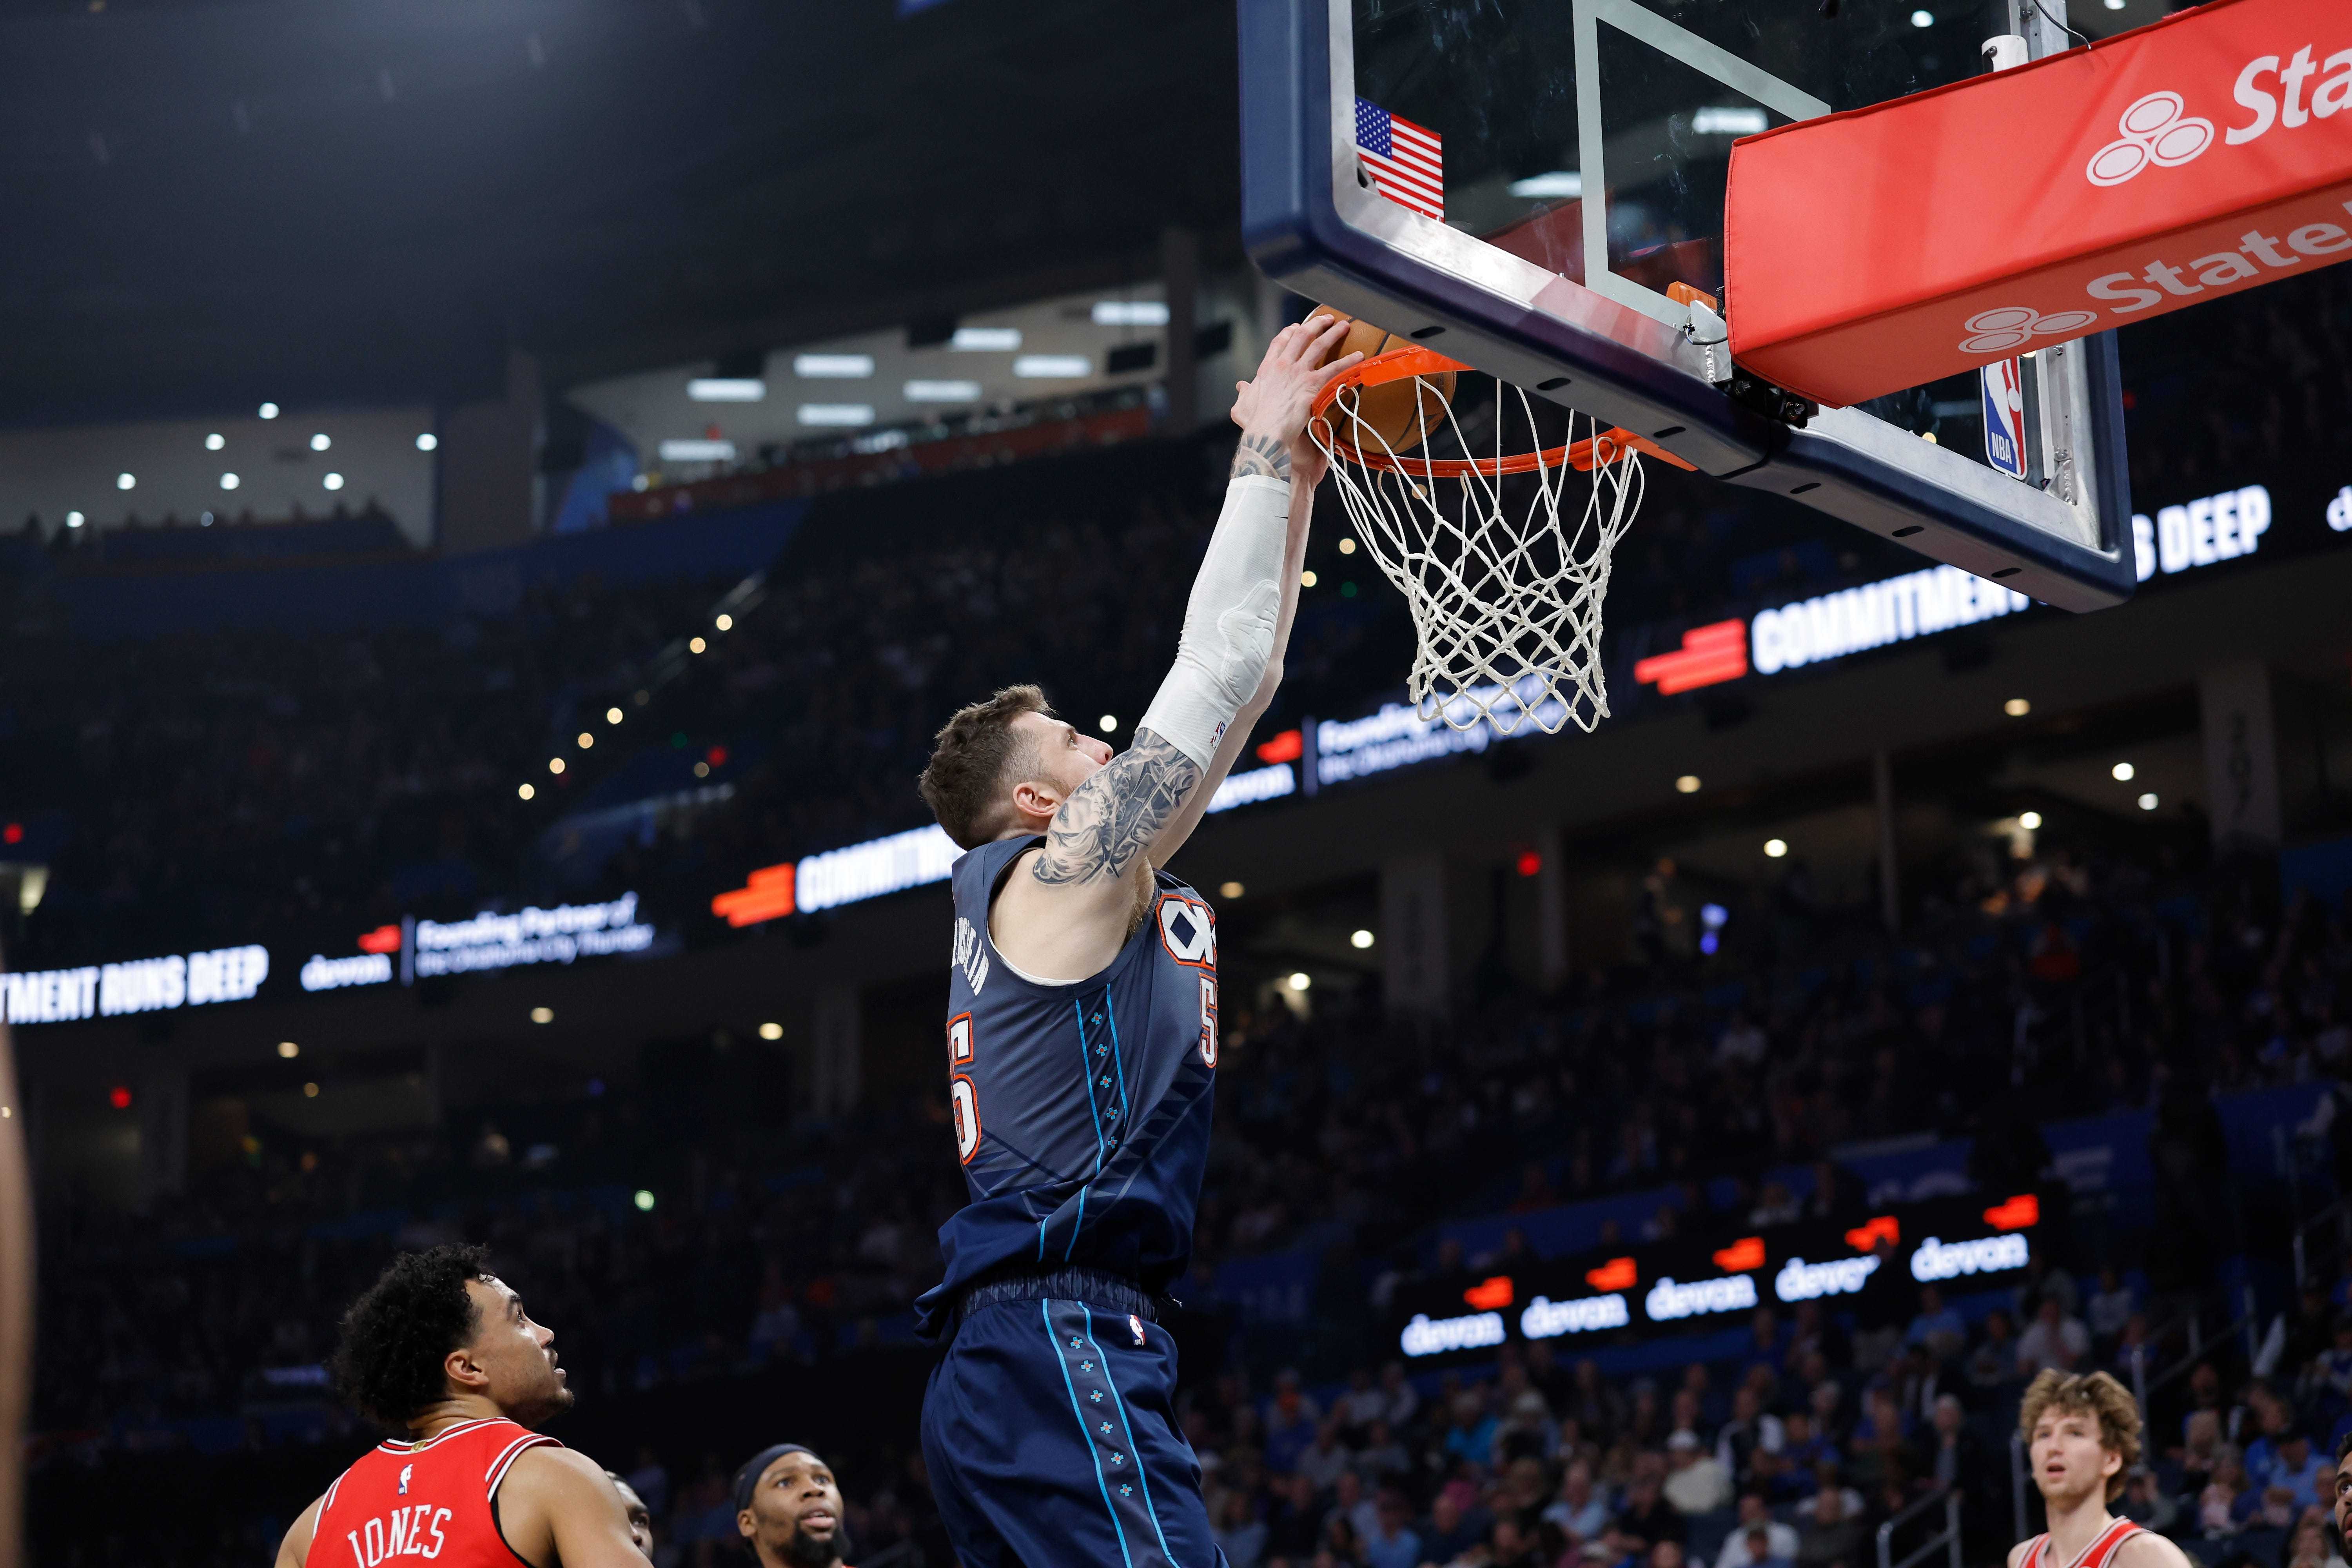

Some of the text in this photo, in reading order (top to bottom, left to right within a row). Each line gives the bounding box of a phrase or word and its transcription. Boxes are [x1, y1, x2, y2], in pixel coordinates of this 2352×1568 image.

[1991, 432, 2012, 464] NBA
[2157, 485, 2271, 574] DEEP
[187, 944, 269, 1006] DEEP
[1401, 1312, 1506, 1357] devon
[1521, 1293, 1630, 1339] devon
[1646, 1274, 1759, 1321] devon
[1911, 1233, 2029, 1282] devon
[347, 1504, 452, 1568] JONES
